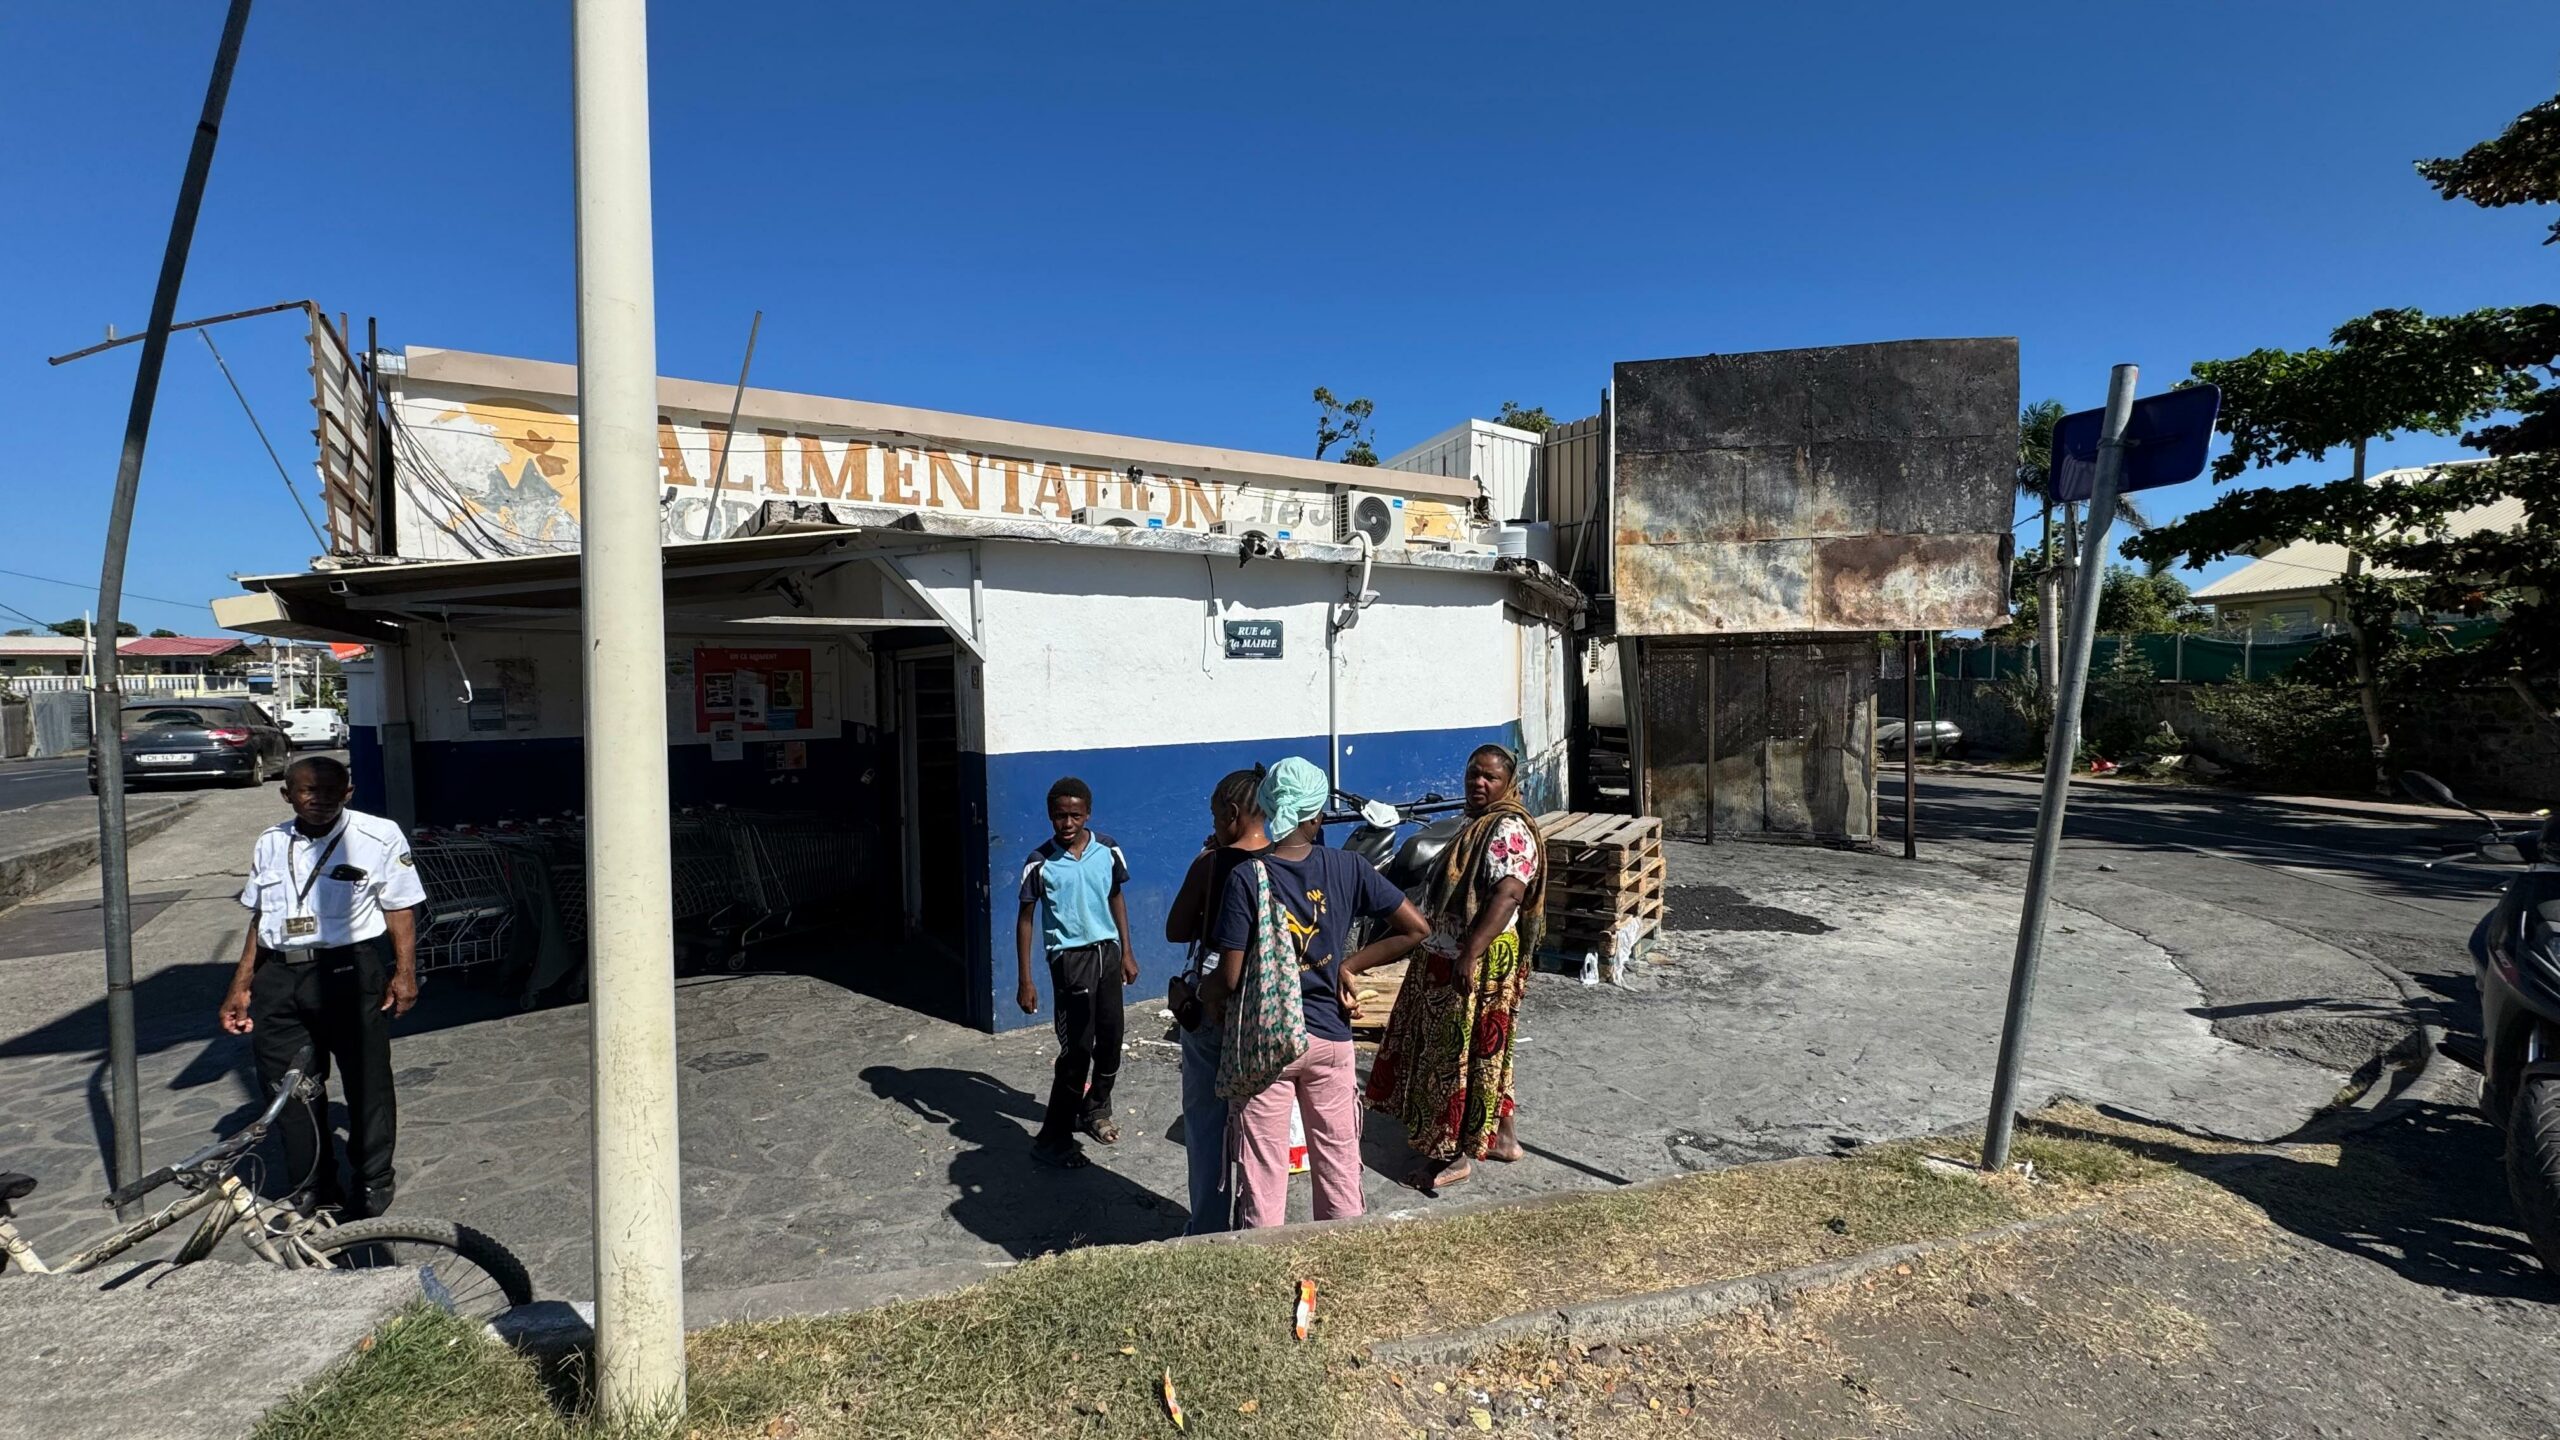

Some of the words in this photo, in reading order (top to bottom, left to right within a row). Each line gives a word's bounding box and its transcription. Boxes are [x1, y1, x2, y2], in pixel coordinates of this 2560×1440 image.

[657, 415, 1225, 529] ALIMENTATION
[1237, 626, 1259, 636] RUE
[1259, 626, 1272, 636] de
[1241, 639, 1278, 649] MAIRIE
